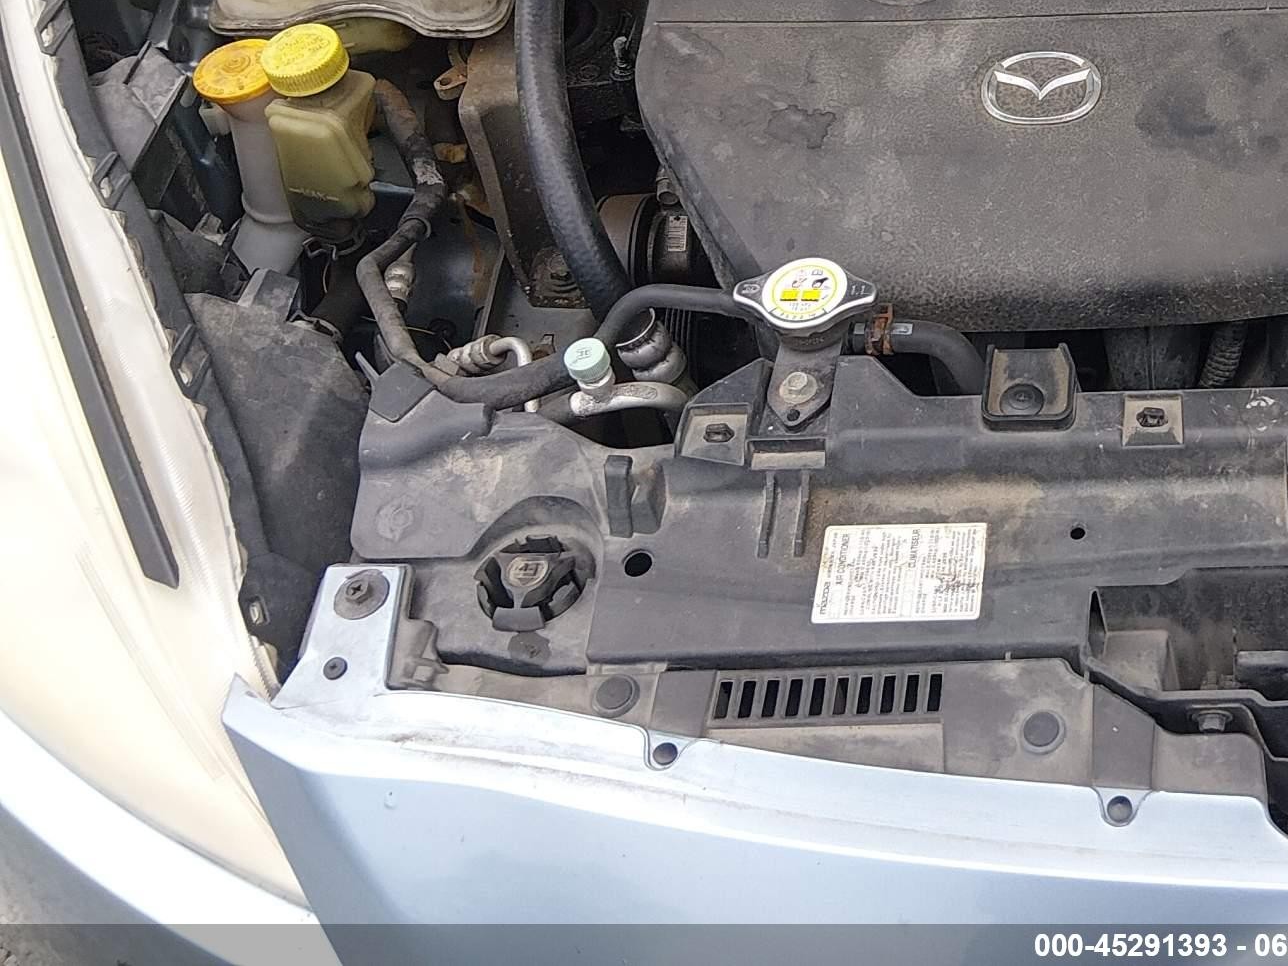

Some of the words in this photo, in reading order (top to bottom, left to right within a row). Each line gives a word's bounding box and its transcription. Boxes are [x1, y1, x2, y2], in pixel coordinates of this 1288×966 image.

[838, 533, 850, 574] CONDITIONER
[908, 528, 921, 569] CLIMATISEUR
[820, 581, 831, 615] mazda
[835, 574, 845, 585] AIR
